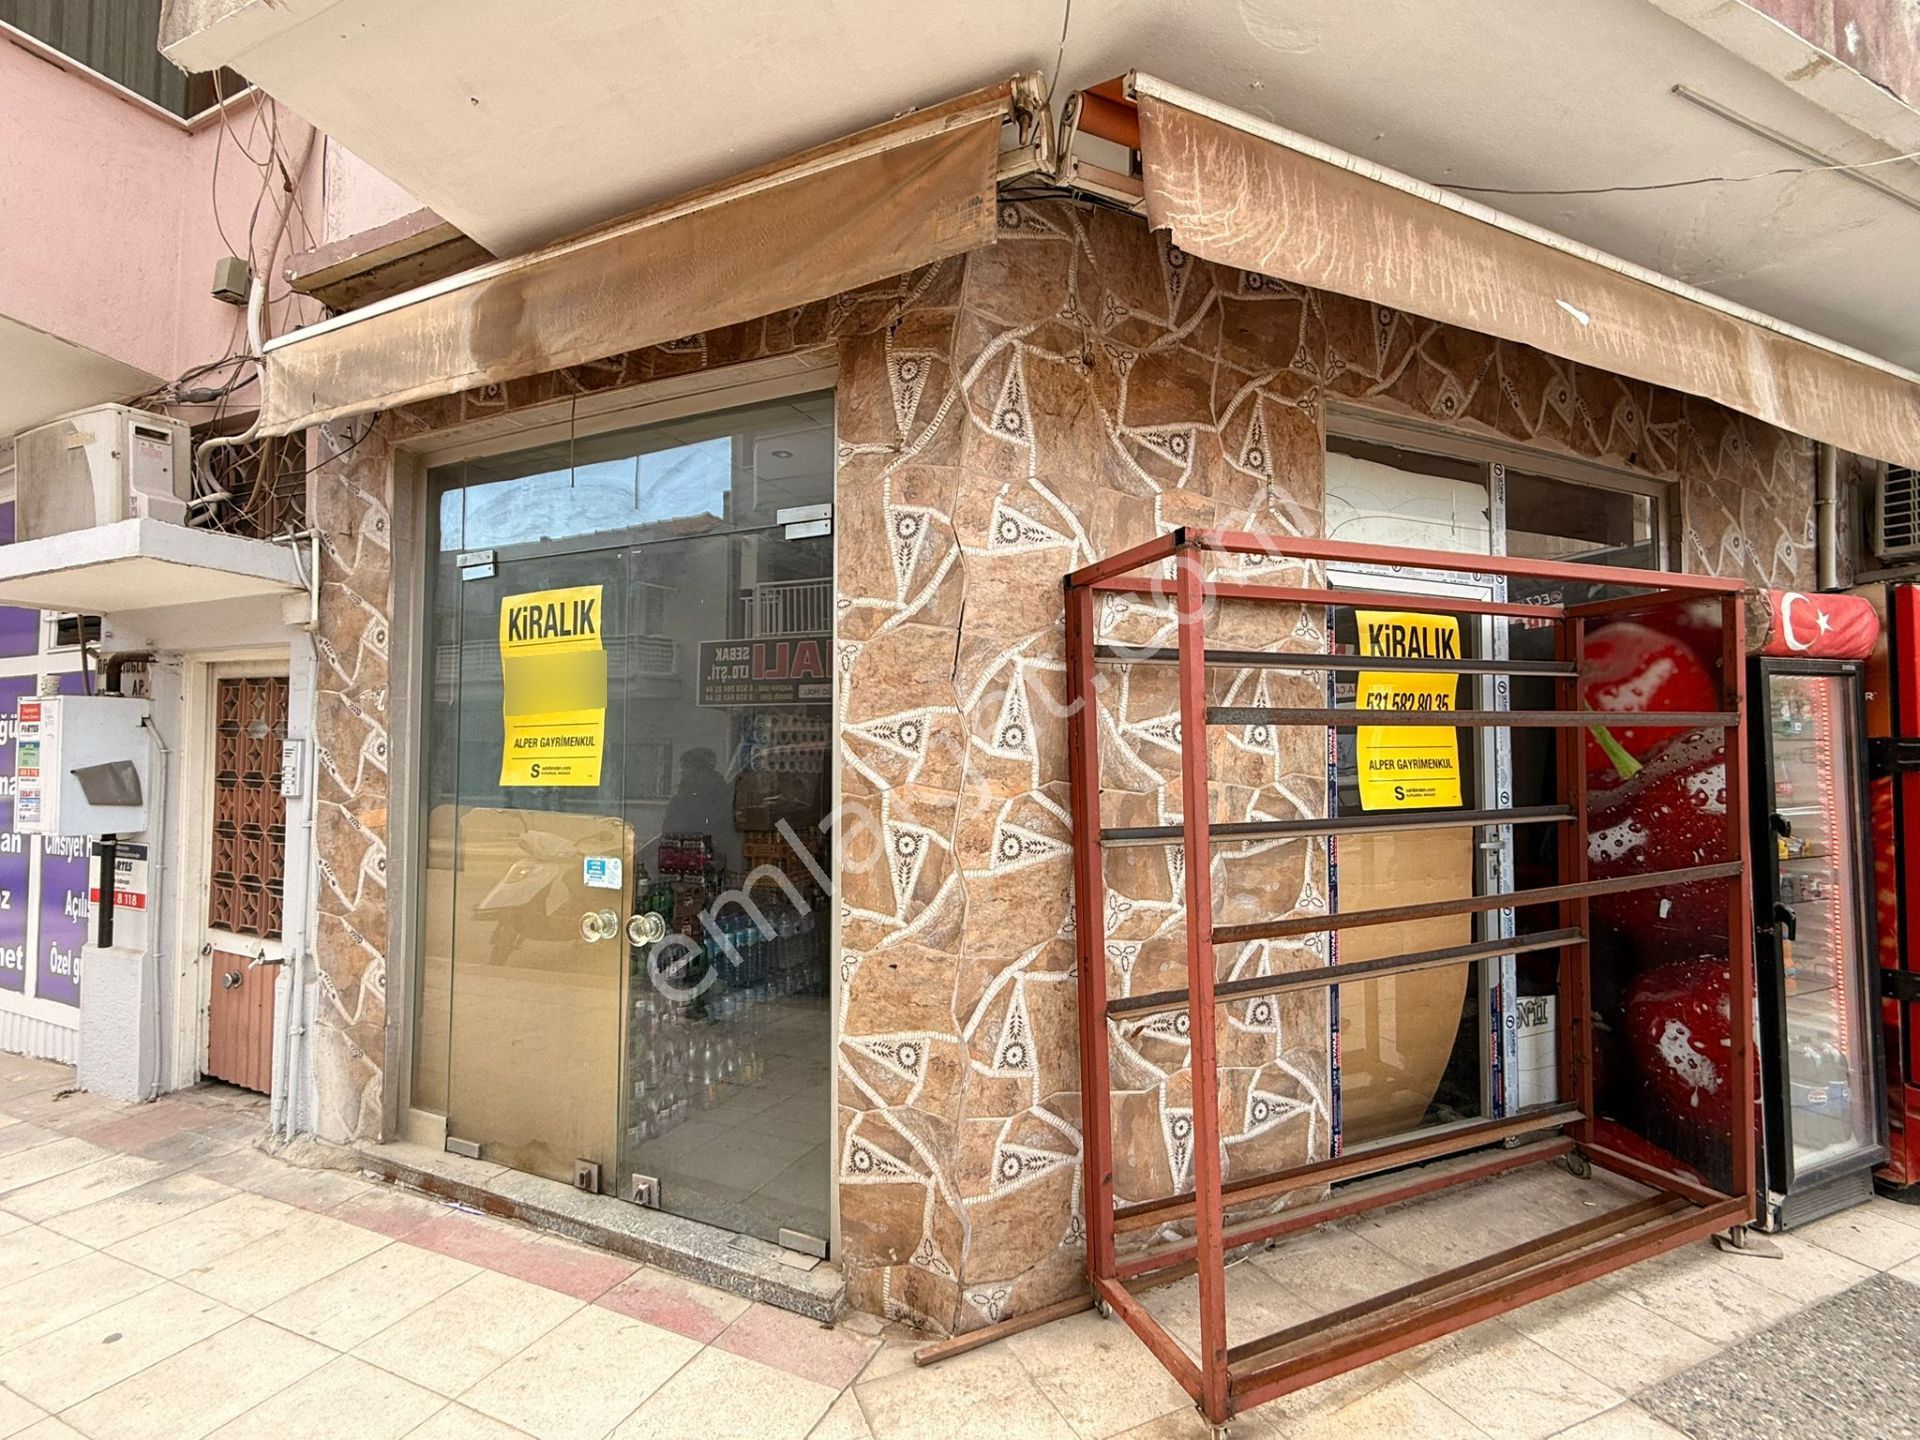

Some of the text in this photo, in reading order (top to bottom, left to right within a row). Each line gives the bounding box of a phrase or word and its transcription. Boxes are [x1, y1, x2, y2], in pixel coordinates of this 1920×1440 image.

[513, 734, 595, 749] ALPER GAYRİMENKUL
[1369, 756, 1453, 770] ALPER GAYRİMENKUL
[0, 832, 21, 853] an
[125, 894, 137, 906] 118
[50, 941, 71, 976] Özel
